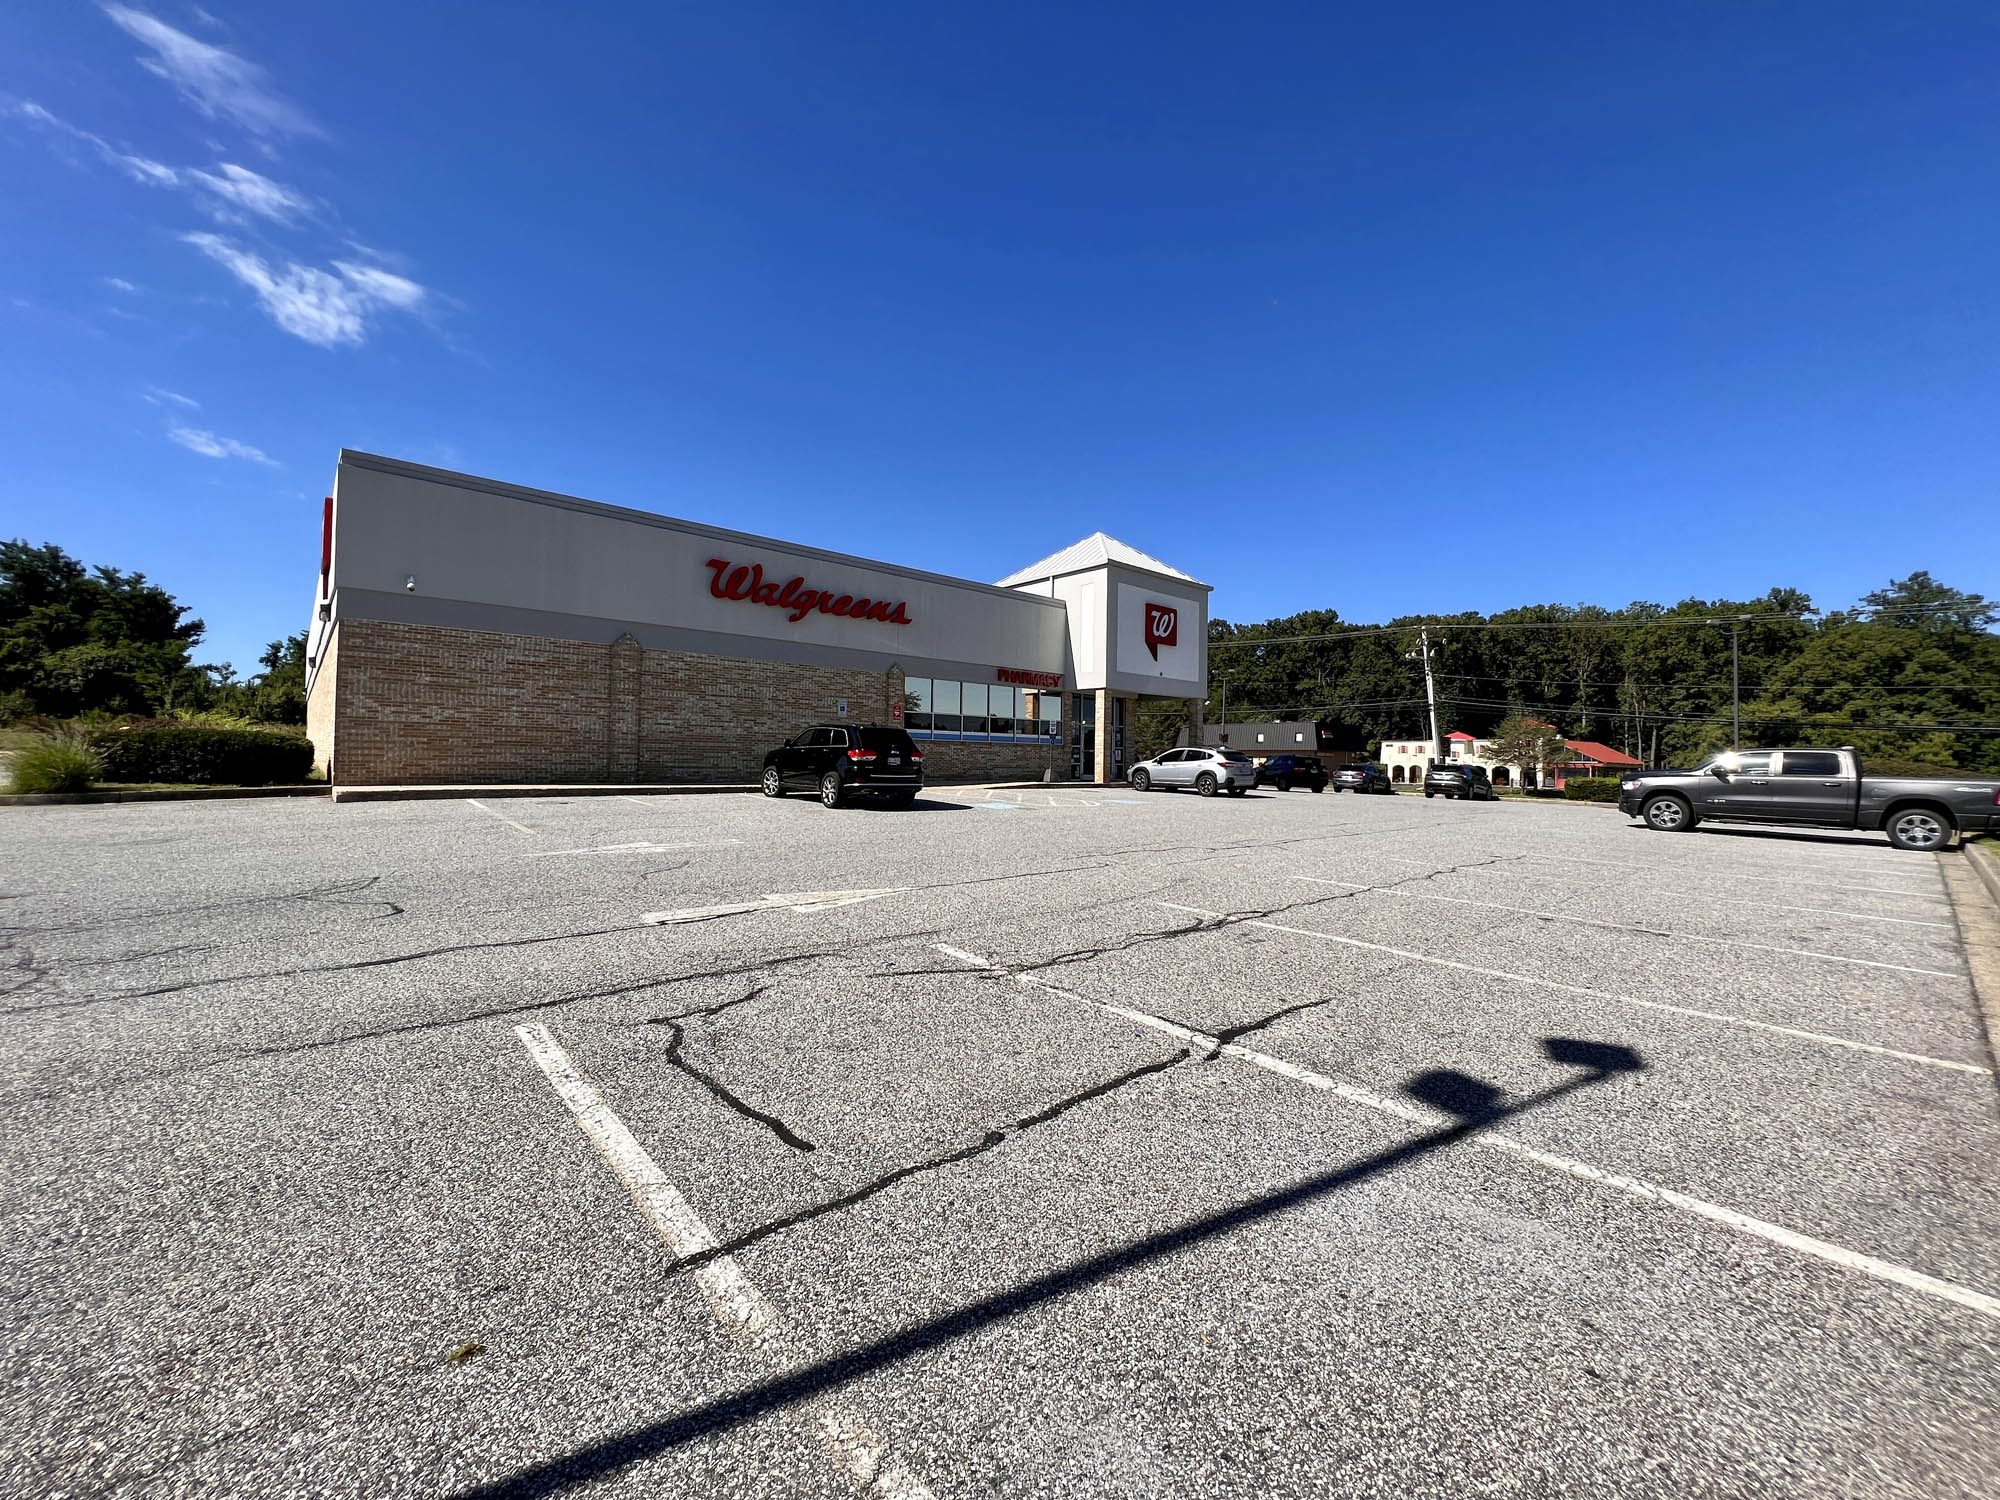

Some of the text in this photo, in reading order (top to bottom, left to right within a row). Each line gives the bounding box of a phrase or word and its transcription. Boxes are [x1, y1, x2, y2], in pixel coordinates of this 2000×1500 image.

[705, 559, 912, 624] Walgreens
[1151, 610, 1175, 637] W
[997, 668, 1063, 688] PHARMACY
